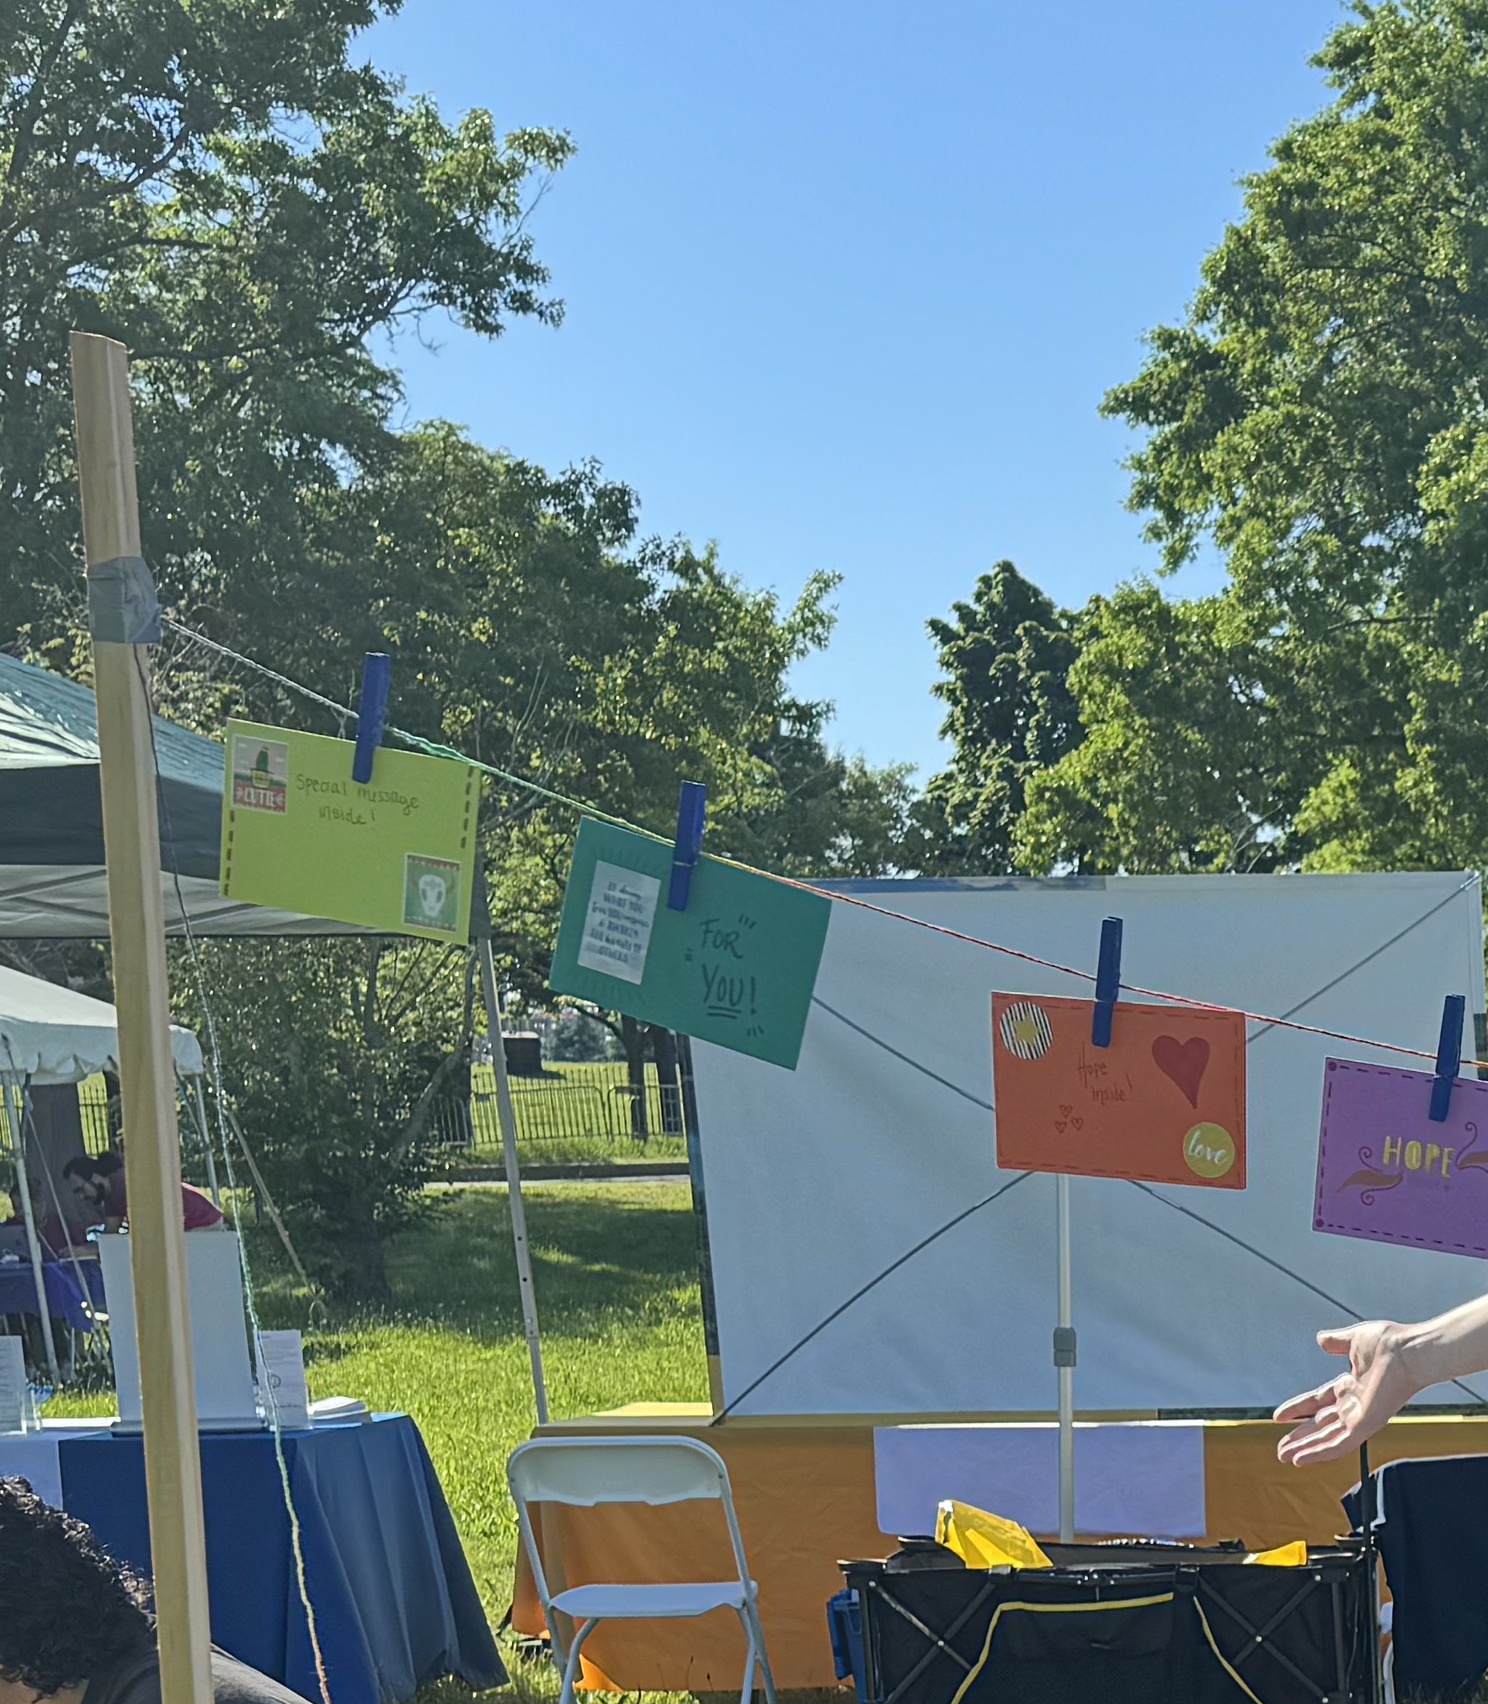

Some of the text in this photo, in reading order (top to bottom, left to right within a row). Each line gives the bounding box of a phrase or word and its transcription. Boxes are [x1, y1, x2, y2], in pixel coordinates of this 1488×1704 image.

[357, 787, 420, 815] message
[699, 918, 744, 959] FOR
[702, 963, 756, 1015] YOU!
[1077, 1042, 1109, 1089] Hope
[1188, 1130, 1228, 1165] love
[1383, 1135, 1455, 1178] HOPE
